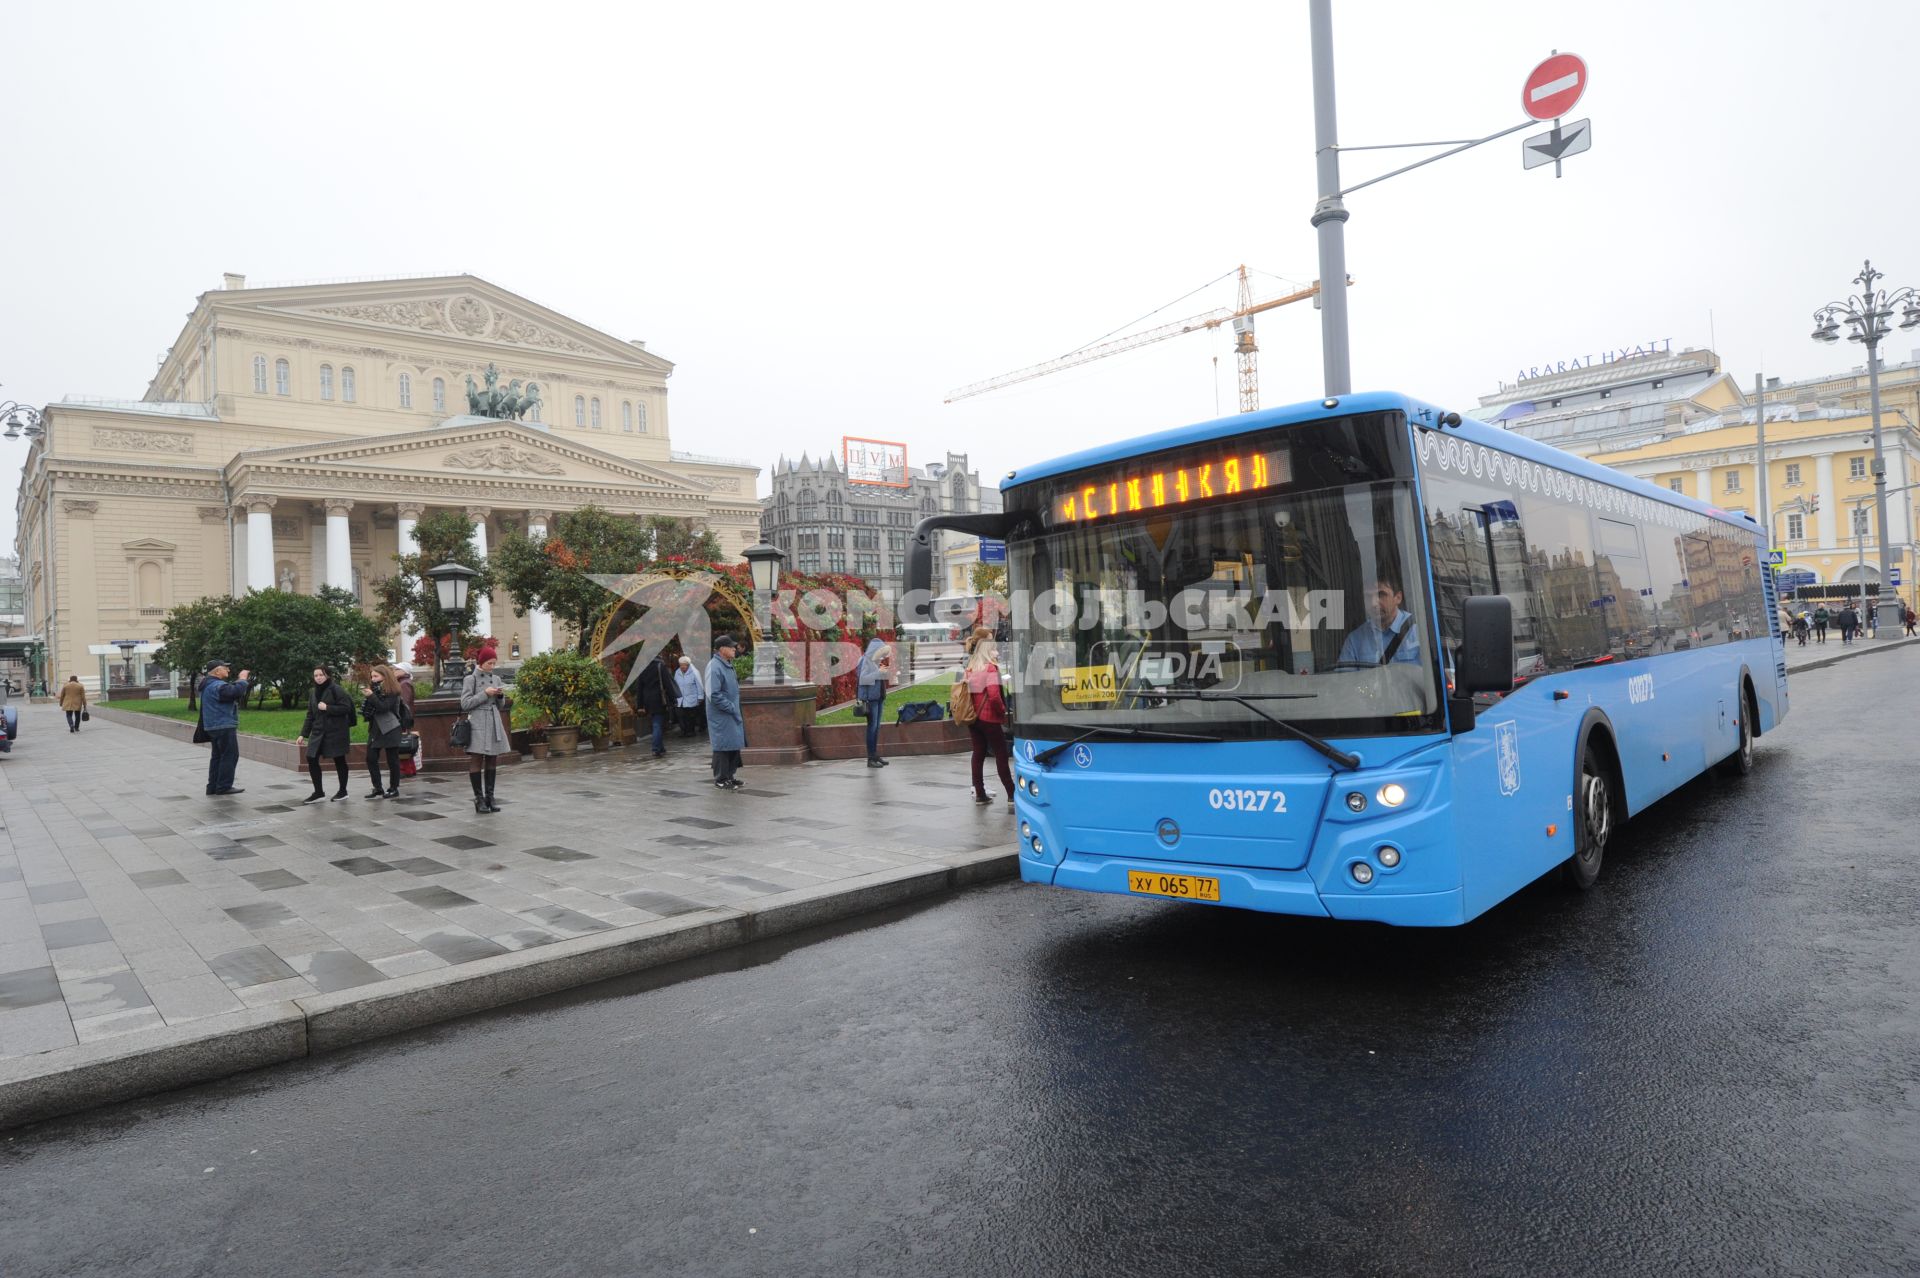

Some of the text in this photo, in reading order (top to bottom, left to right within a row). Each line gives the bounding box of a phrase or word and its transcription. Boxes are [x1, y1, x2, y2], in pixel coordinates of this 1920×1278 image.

[1518, 338, 1673, 381] ARARAT HYATT
[1209, 788, 1287, 813] 031272
[1159, 876, 1189, 895] 065
[1197, 879, 1213, 893] 77
